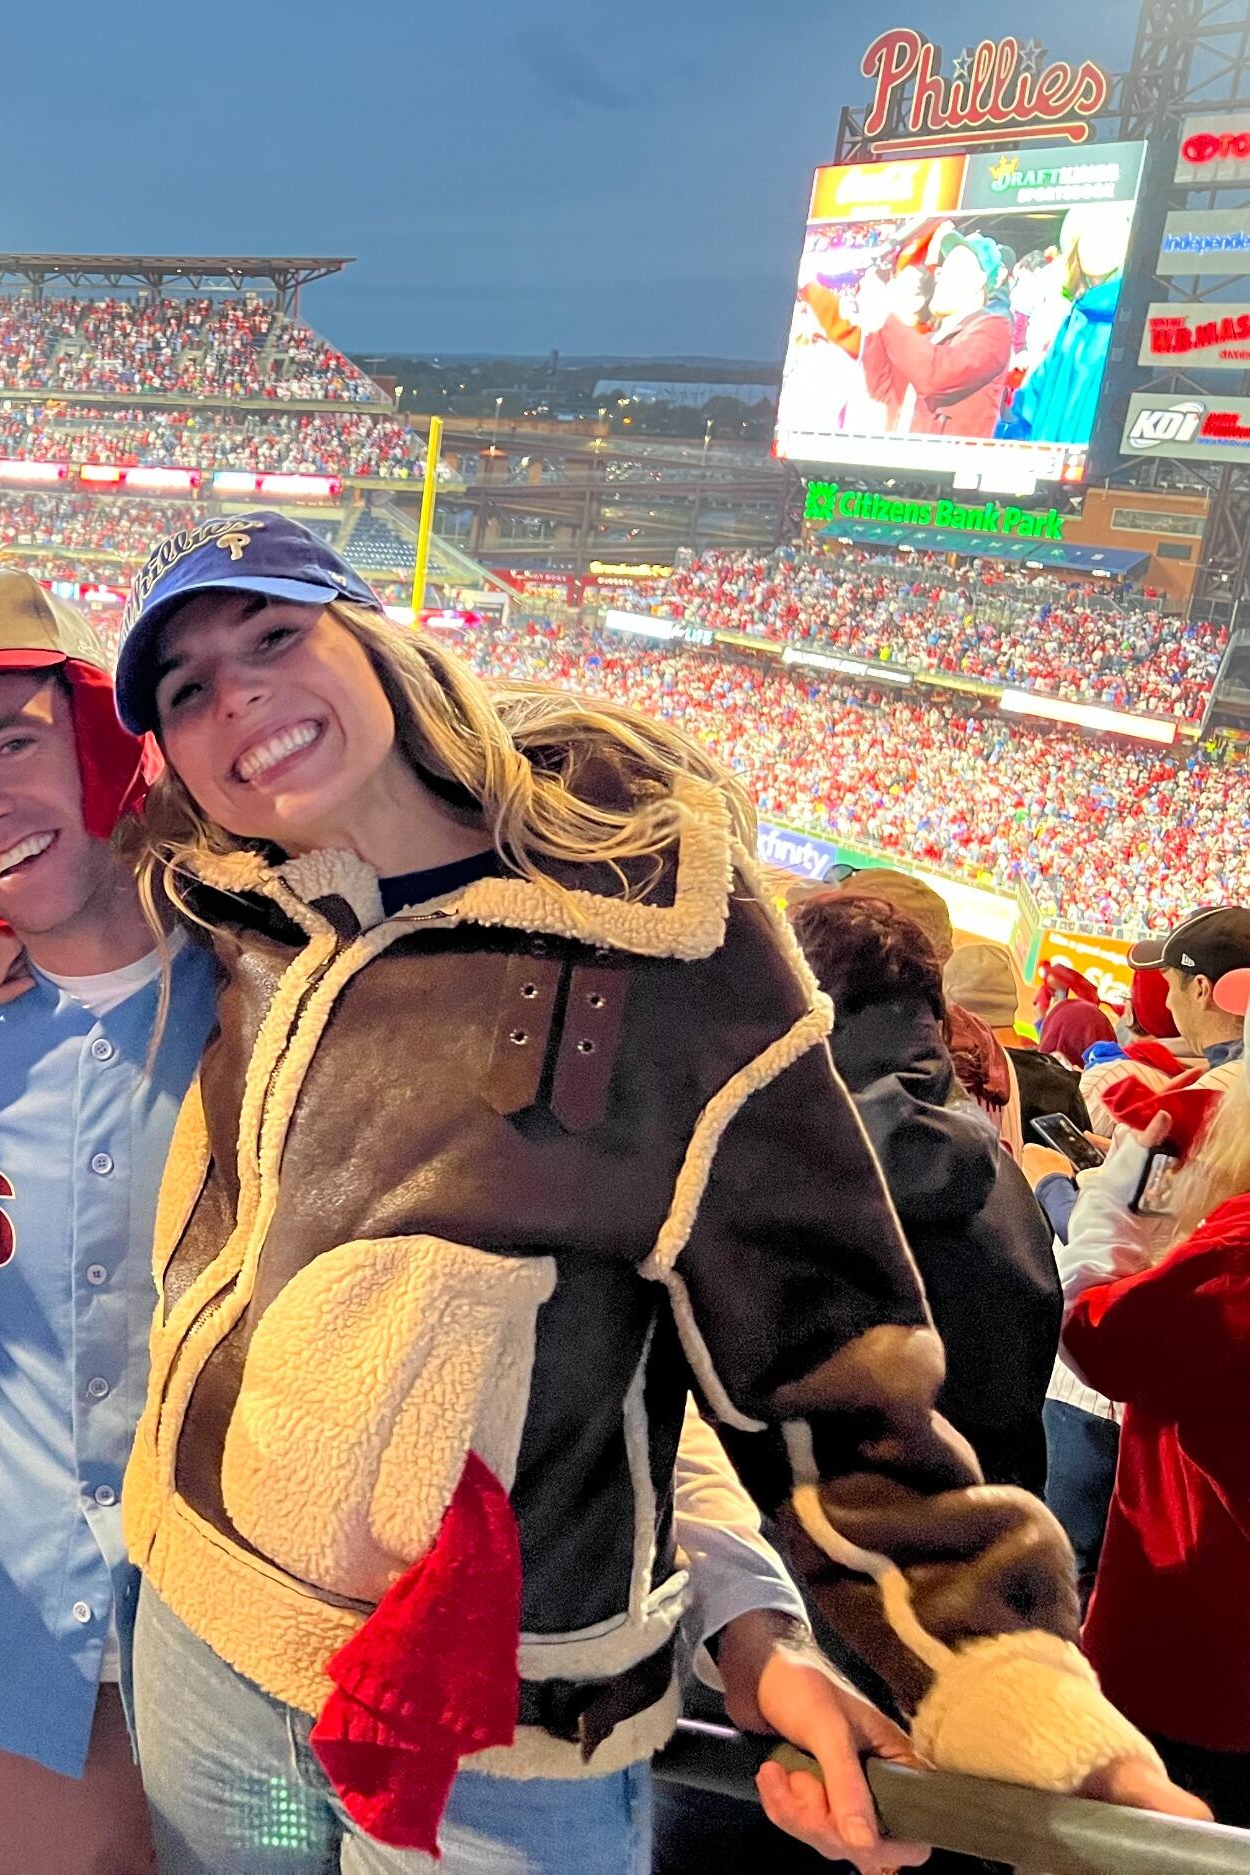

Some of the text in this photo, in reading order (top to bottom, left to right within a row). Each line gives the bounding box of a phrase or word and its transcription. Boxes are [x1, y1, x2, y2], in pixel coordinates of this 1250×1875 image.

[861, 28, 1106, 136] Phillies
[840, 491, 1065, 540] Citizens Bank Park
